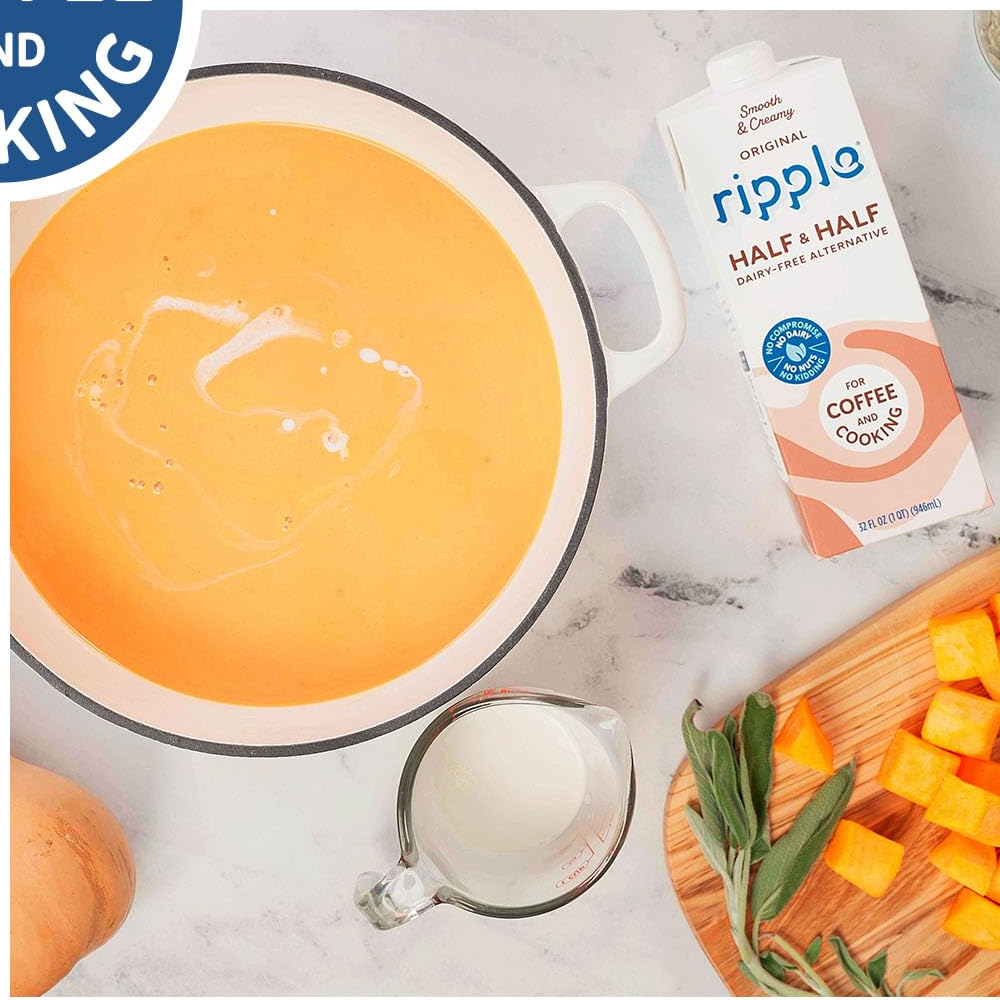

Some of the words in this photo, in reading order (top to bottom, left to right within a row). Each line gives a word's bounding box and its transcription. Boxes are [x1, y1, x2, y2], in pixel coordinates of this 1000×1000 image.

[736, 122, 748, 136] &
[749, 107, 795, 131] Creamy
[740, 94, 783, 118] Smooth
[739, 130, 808, 161] ORIGINAL
[712, 144, 865, 225] ripple
[728, 233, 793, 272] HALF
[799, 232, 810, 244] &
[814, 203, 879, 241] HALF
[736, 255, 807, 287] DAIRY-FREE
[809, 226, 889, 261] ALTERNATIVE
[766, 342, 774, 354] NO
[770, 321, 822, 341] COMPROMISE
[775, 336, 786, 349] NO
[786, 330, 812, 340] DAIRY
[779, 370, 793, 380] NO
[794, 358, 825, 381] KIDDING
[783, 363, 797, 373] NO
[798, 354, 817, 372] NUTS
[845, 377, 865, 390] FOR
[826, 383, 898, 419] COFFEE
[836, 406, 902, 446] COOKING
[857, 413, 878, 426] AND
[858, 521, 868, 532] 32
[868, 519, 876, 529] FL
[877, 515, 888, 526] OZ
[896, 508, 910, 519] QT)
[910, 498, 942, 517] (946mL)
